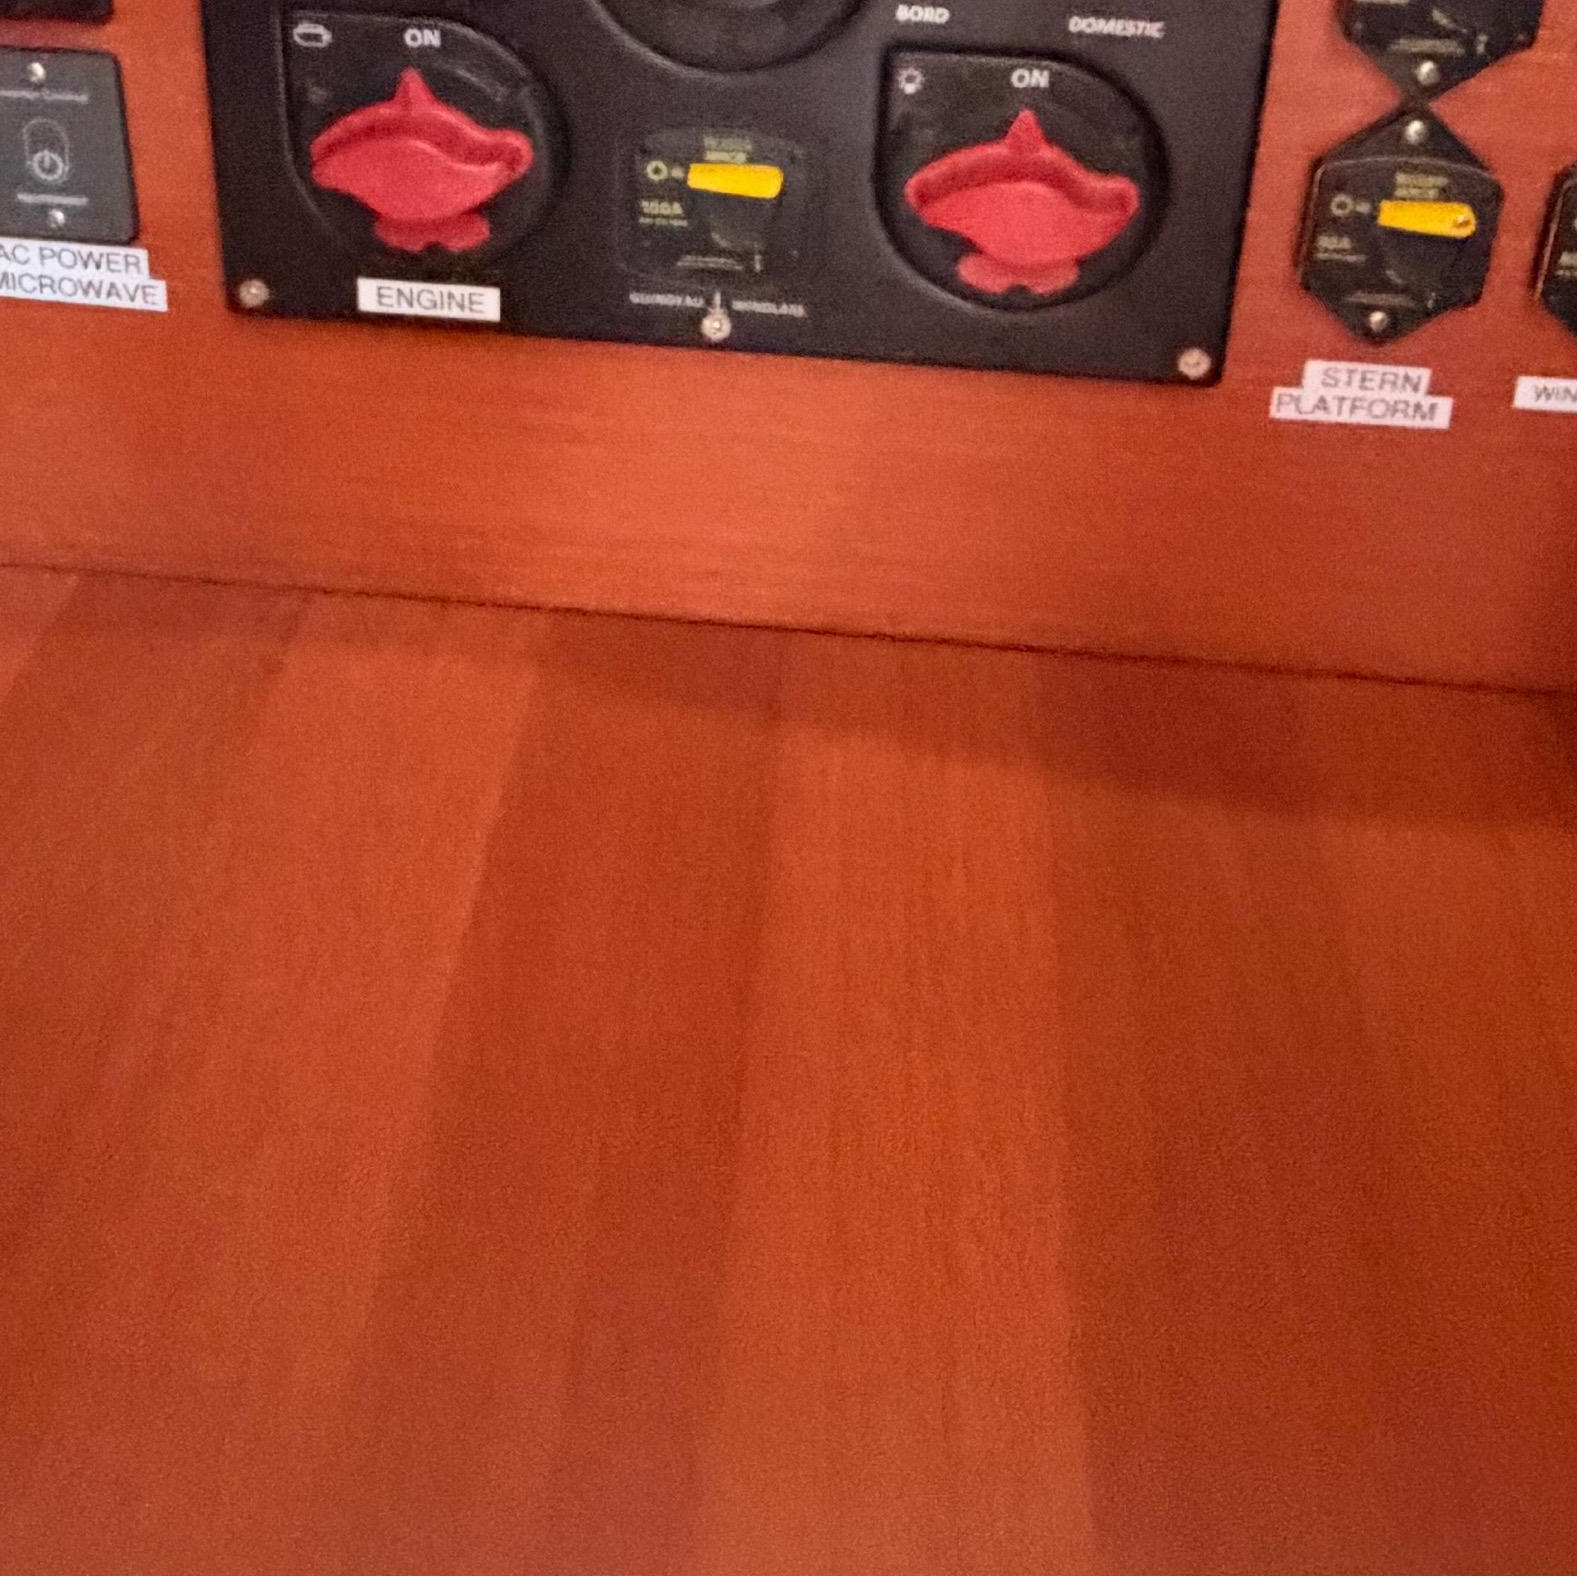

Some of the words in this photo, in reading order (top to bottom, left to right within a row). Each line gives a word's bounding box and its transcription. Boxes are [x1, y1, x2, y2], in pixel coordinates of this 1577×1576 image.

[896, 4, 951, 26] BORD
[1068, 15, 1167, 40] DOMESTIC
[403, 28, 442, 48] ON
[1010, 68, 1051, 90] ON
[38, 247, 142, 275] POWER
[375, 285, 488, 315] ENGINE
[1320, 366, 1422, 394] STERN
[1276, 393, 1439, 423] PLATFORM
